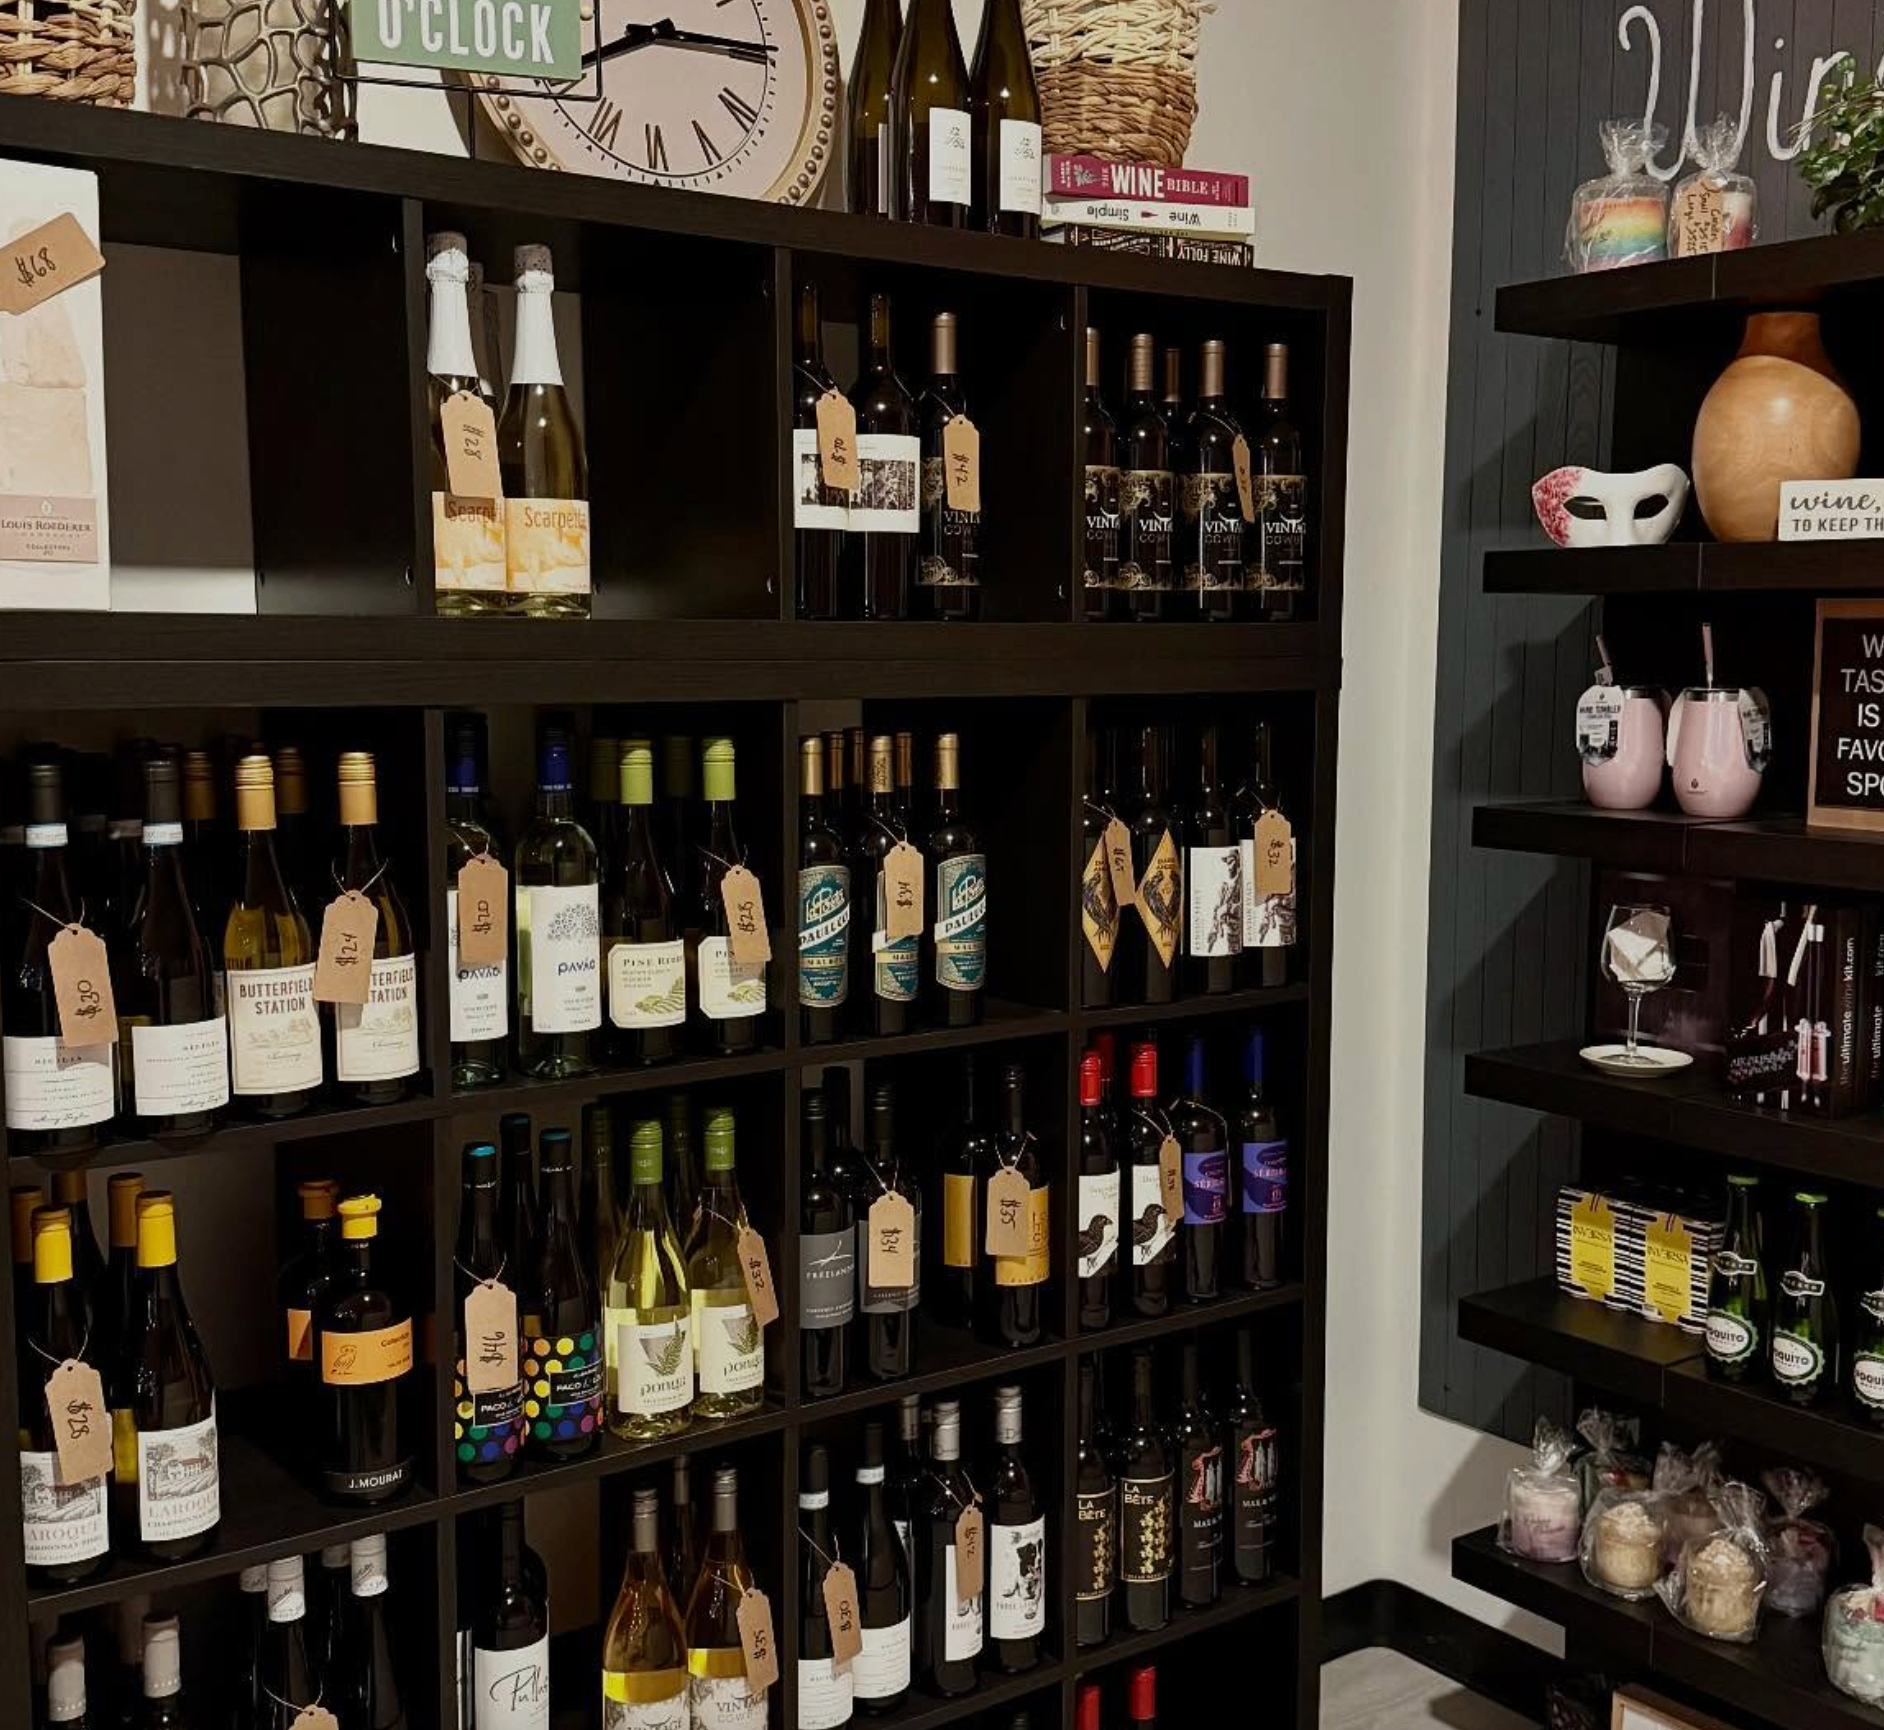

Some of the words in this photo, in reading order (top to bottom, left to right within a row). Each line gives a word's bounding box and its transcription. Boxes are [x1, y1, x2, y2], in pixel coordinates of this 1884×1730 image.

[377, 0, 555, 65] O'CLOCK
[1110, 163, 1166, 199] WINE
[1166, 177, 1209, 196] BIBLE
[1086, 206, 1130, 222] Simple
[1169, 211, 1202, 226] Wine
[15, 246, 59, 288] $68
[1177, 246, 1210, 263] FOLLY
[1212, 249, 1242, 267] WINE
[463, 423, 486, 461] $28
[949, 452, 969, 486] $42
[1790, 490, 1881, 514] wine,
[1, 519, 33, 531] LOUIS
[36, 520, 92, 532] ROEDERER
[1791, 518, 1812, 532] TO
[1817, 517, 1859, 532] KEEP
[1857, 702, 1881, 728] IS
[1846, 770, 1884, 798] SP
[335, 931, 359, 967] $24
[73, 979, 103, 1019] $30
[239, 977, 314, 999] BUTTERFIELD
[254, 997, 306, 1015] STATION
[1000, 1197, 1022, 1231] $35
[880, 1227, 904, 1254] $34
[748, 1257, 765, 1292] $32
[478, 1331, 508, 1368] $46
[67, 1398, 94, 1441] $28
[1124, 1482, 1140, 1494] LA
[1078, 1500, 1095, 1510] LA
